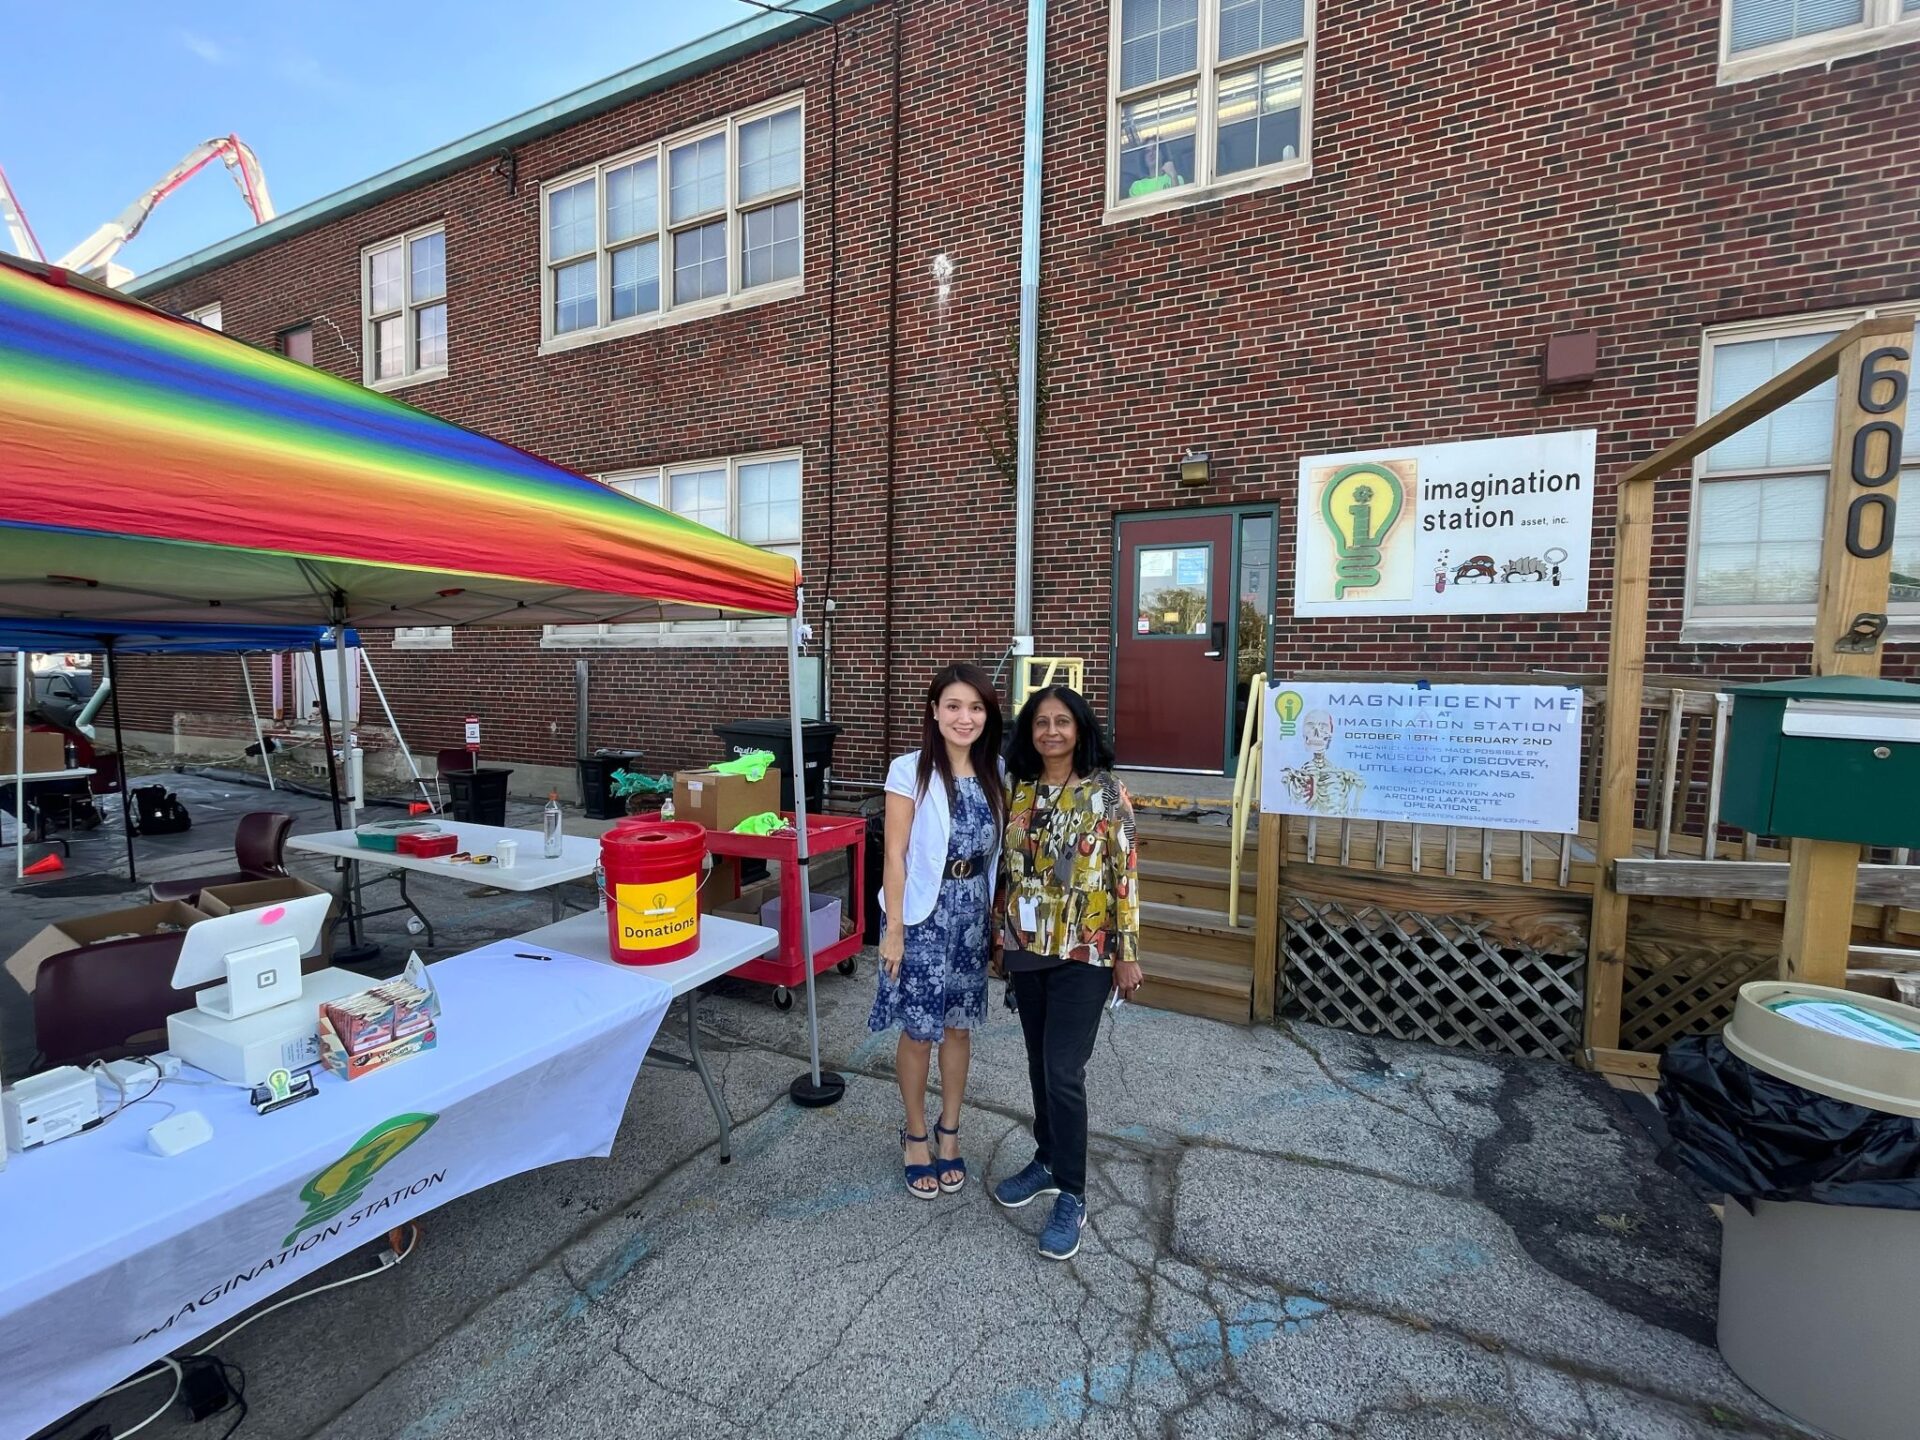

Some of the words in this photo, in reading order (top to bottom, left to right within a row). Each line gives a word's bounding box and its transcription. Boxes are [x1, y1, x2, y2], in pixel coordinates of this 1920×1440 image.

[1845, 346, 1910, 560] 600
[1424, 469, 1581, 503] imagination
[1423, 505, 1514, 532] station
[1520, 516, 1549, 527] asset,
[1552, 515, 1569, 525] inc.
[1328, 694, 1521, 710] MAGNIFICENT
[1534, 696, 1576, 711] ME
[1337, 717, 1464, 730] IMAGINATION
[1473, 721, 1562, 733] STATION
[1344, 732, 1402, 741] OCTOBER
[1408, 734, 1438, 742] 18TH
[1449, 736, 1519, 745] FEBRUARY
[1522, 738, 1553, 746] 2ND
[1346, 751, 1373, 760] THE
[1376, 752, 1436, 762] MUSEUM
[1440, 755, 1460, 763] OF
[1463, 756, 1550, 768] DISCOVERY,
[1359, 764, 1399, 773] LITTLE
[1403, 766, 1446, 775] ROCK,
[1449, 768, 1535, 779] ARKANSAS.
[1373, 785, 1418, 793] ARCONIC
[1421, 787, 1489, 797] FOUNDATION
[1492, 791, 1516, 799] AND
[1384, 793, 1435, 802] ARCONIC
[1439, 796, 1502, 806] LAFAYETTE
[1404, 801, 1481, 812] OPERATIONS.
[624, 917, 695, 938] Donations
[132, 1221, 343, 1344] IMAGINATION
[347, 1168, 447, 1228] STATION
